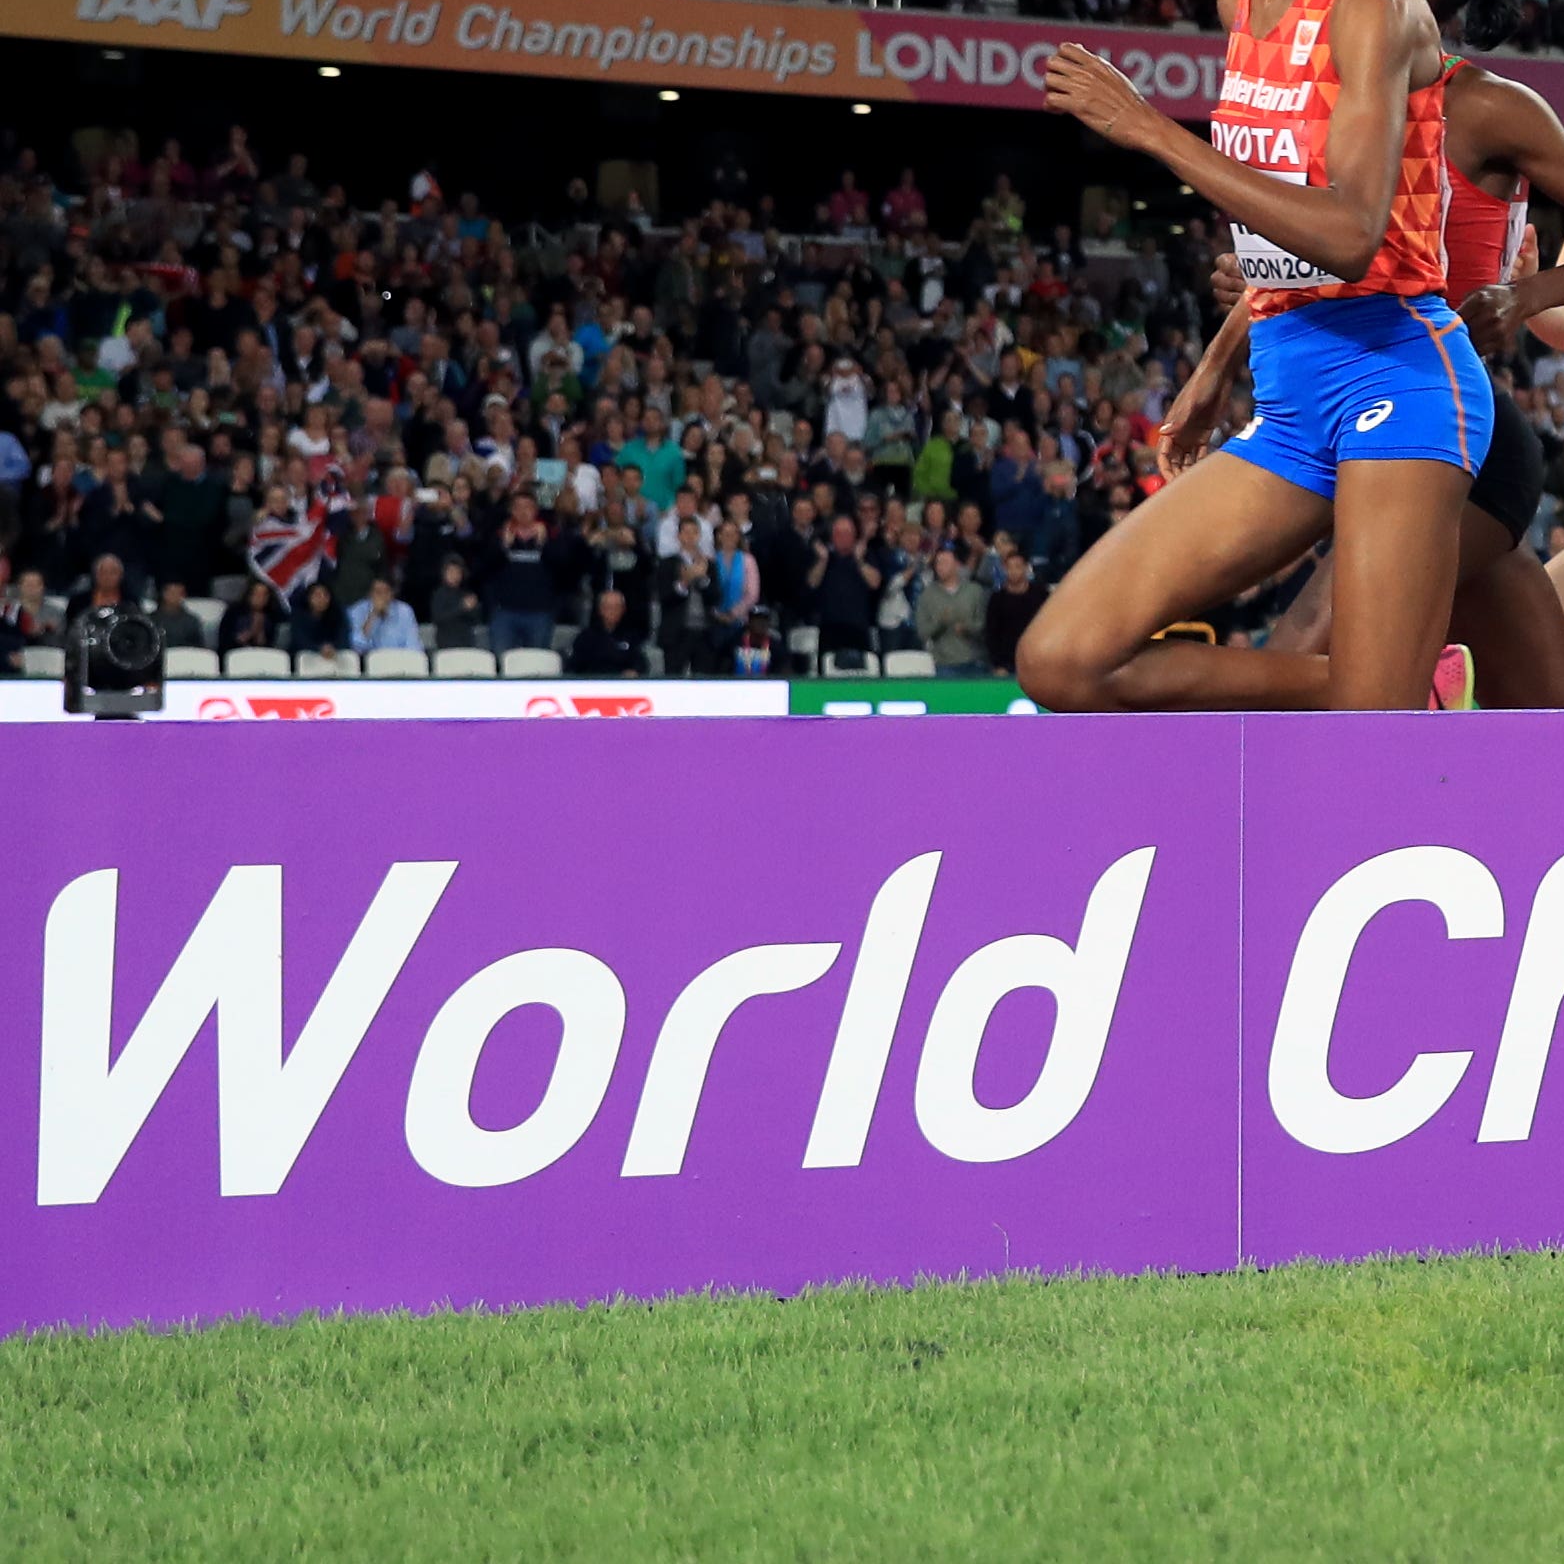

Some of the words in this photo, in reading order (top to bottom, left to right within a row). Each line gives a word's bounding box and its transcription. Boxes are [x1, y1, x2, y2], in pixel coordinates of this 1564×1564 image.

[455, 3, 837, 83] Championships
[856, 32, 1112, 91] LONDO
[1122, 49, 1225, 100] 201
[37, 845, 1157, 1206] World
